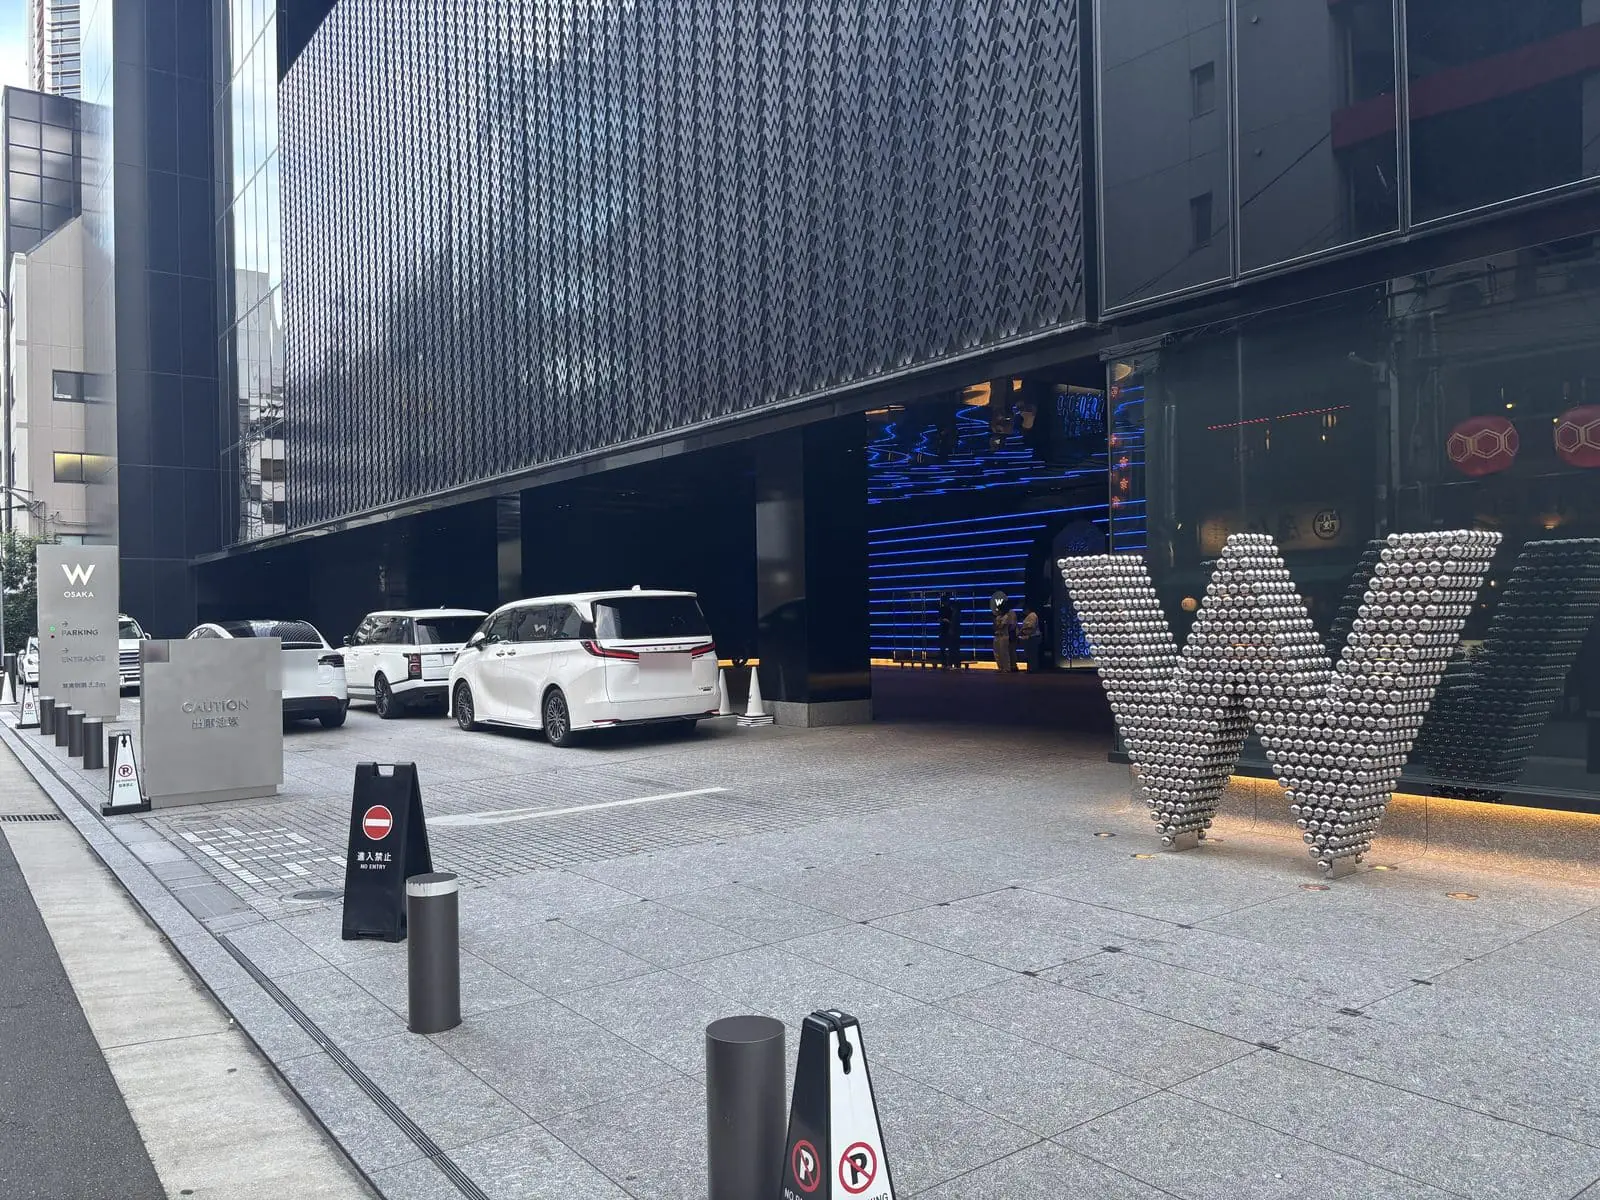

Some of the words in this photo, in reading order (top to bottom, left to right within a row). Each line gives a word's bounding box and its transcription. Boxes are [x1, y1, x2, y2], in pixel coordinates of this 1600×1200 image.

[61, 563, 95, 586] W
[61, 629, 99, 637] PARKING
[61, 655, 106, 663] ENTRANCE
[181, 698, 249, 714] CAUTION
